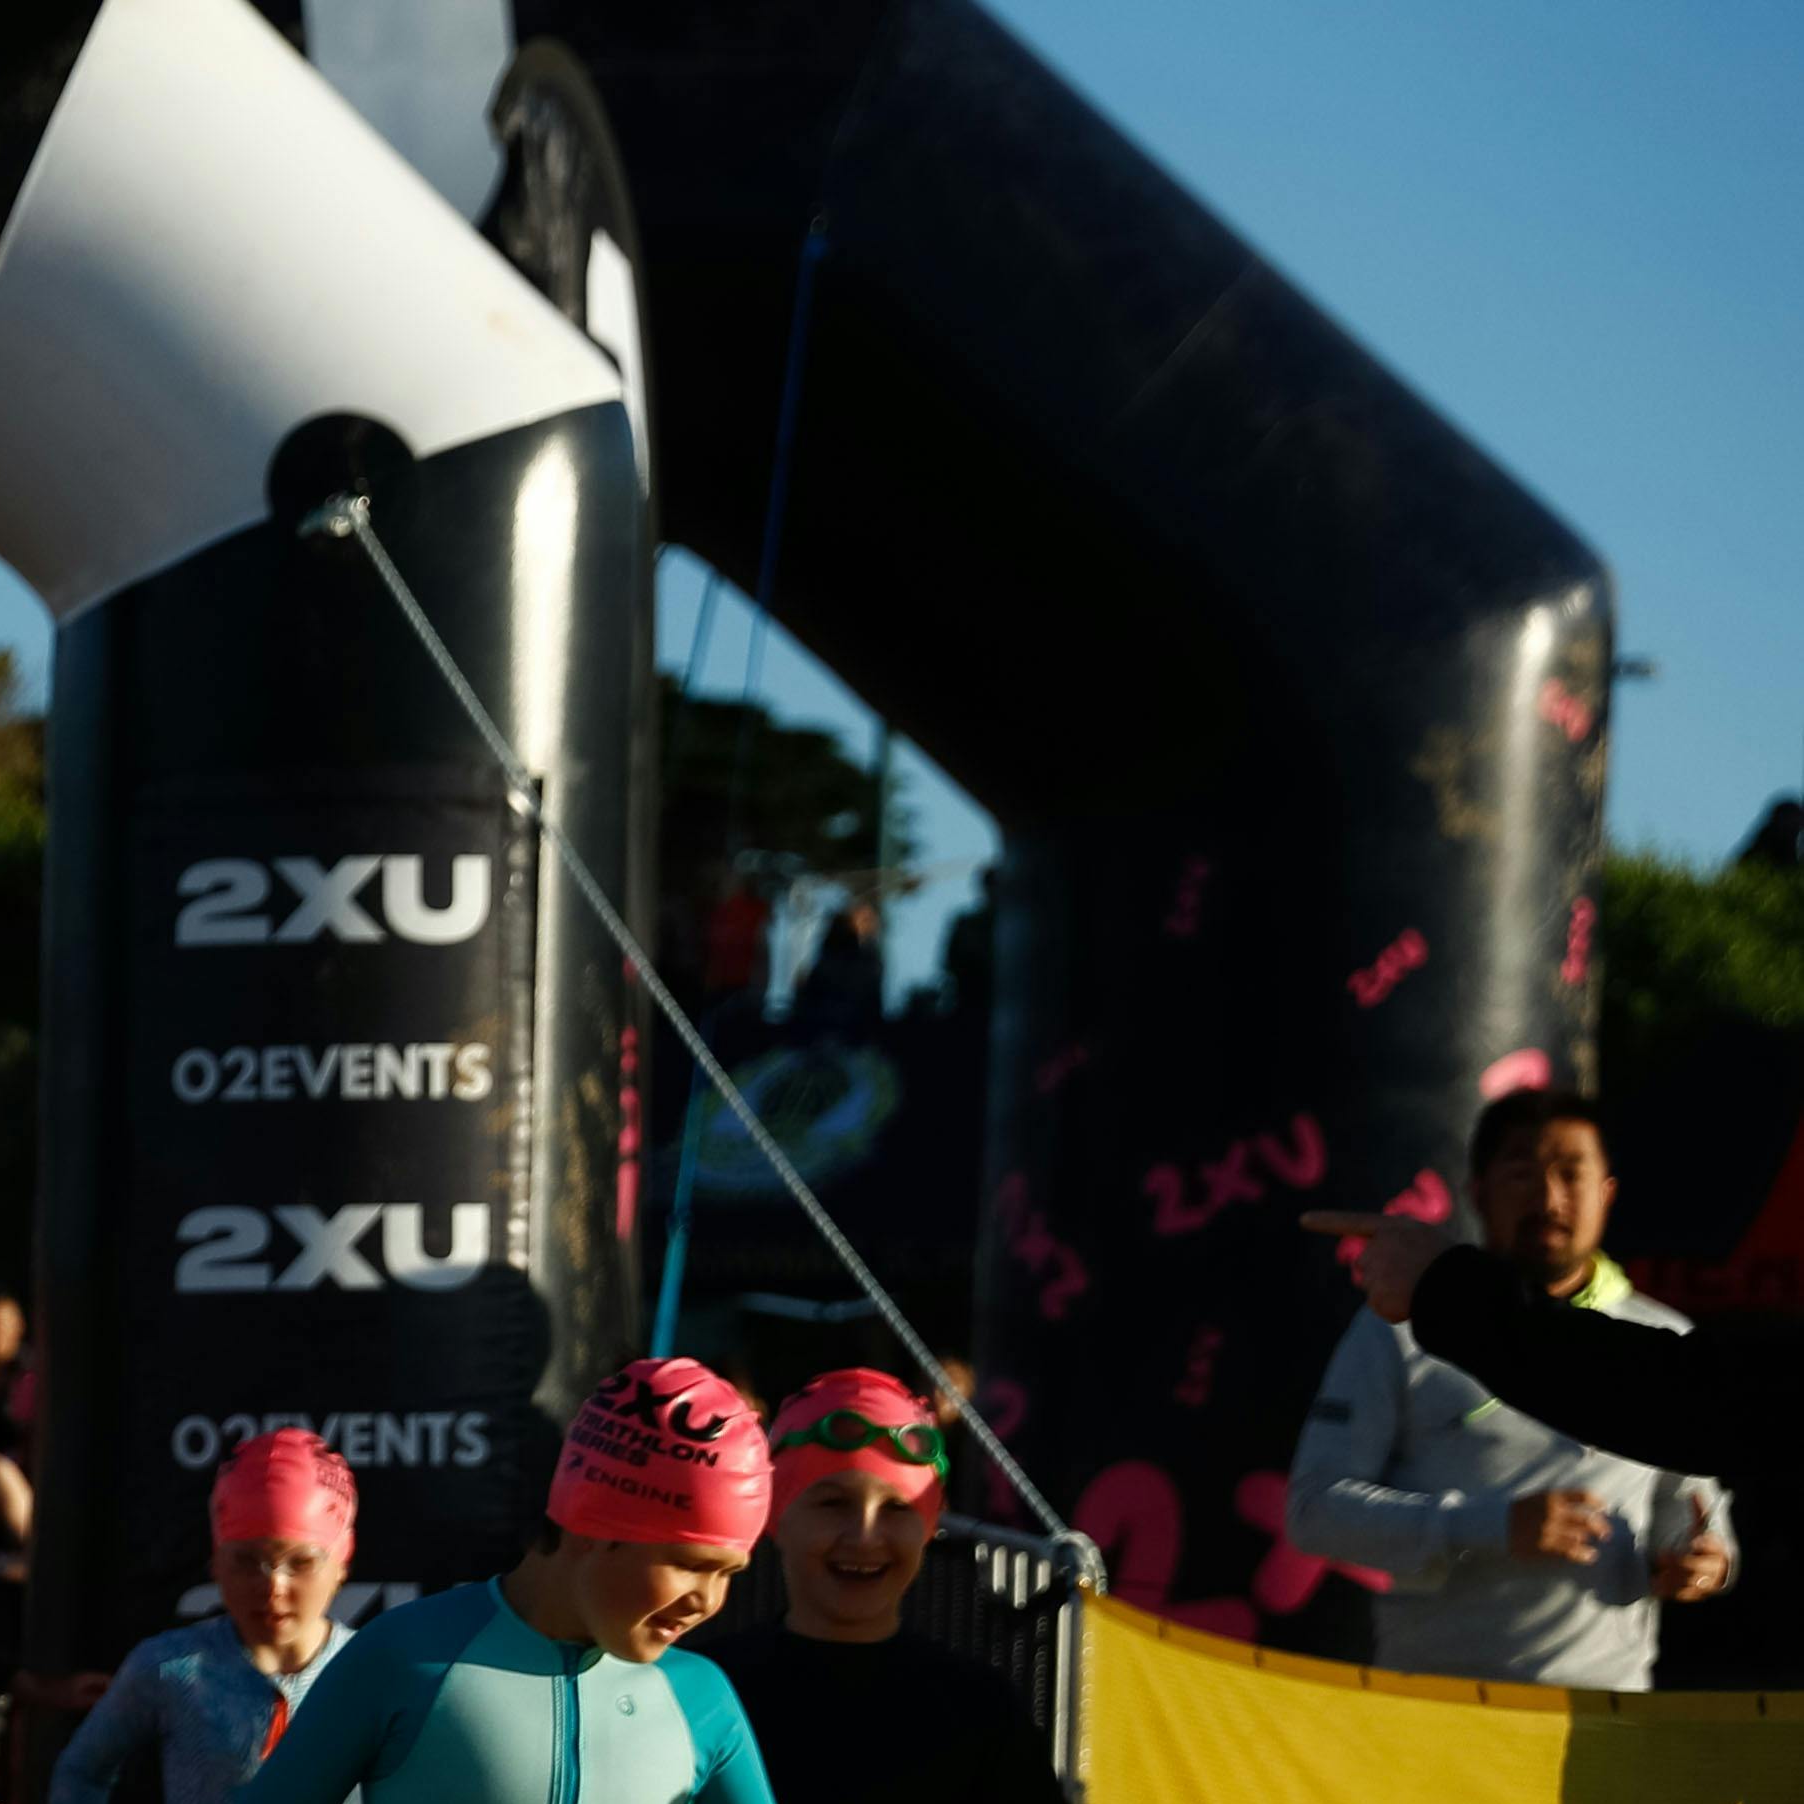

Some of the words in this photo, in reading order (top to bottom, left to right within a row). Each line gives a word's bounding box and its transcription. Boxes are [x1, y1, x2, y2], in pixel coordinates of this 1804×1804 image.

[175, 853, 490, 946] 2XU
[172, 1043, 493, 1102] O2EVENTS
[175, 1202, 490, 1291] 2XU
[591, 1372, 728, 1443] 2XU
[584, 1465, 693, 1511] ENGINE
